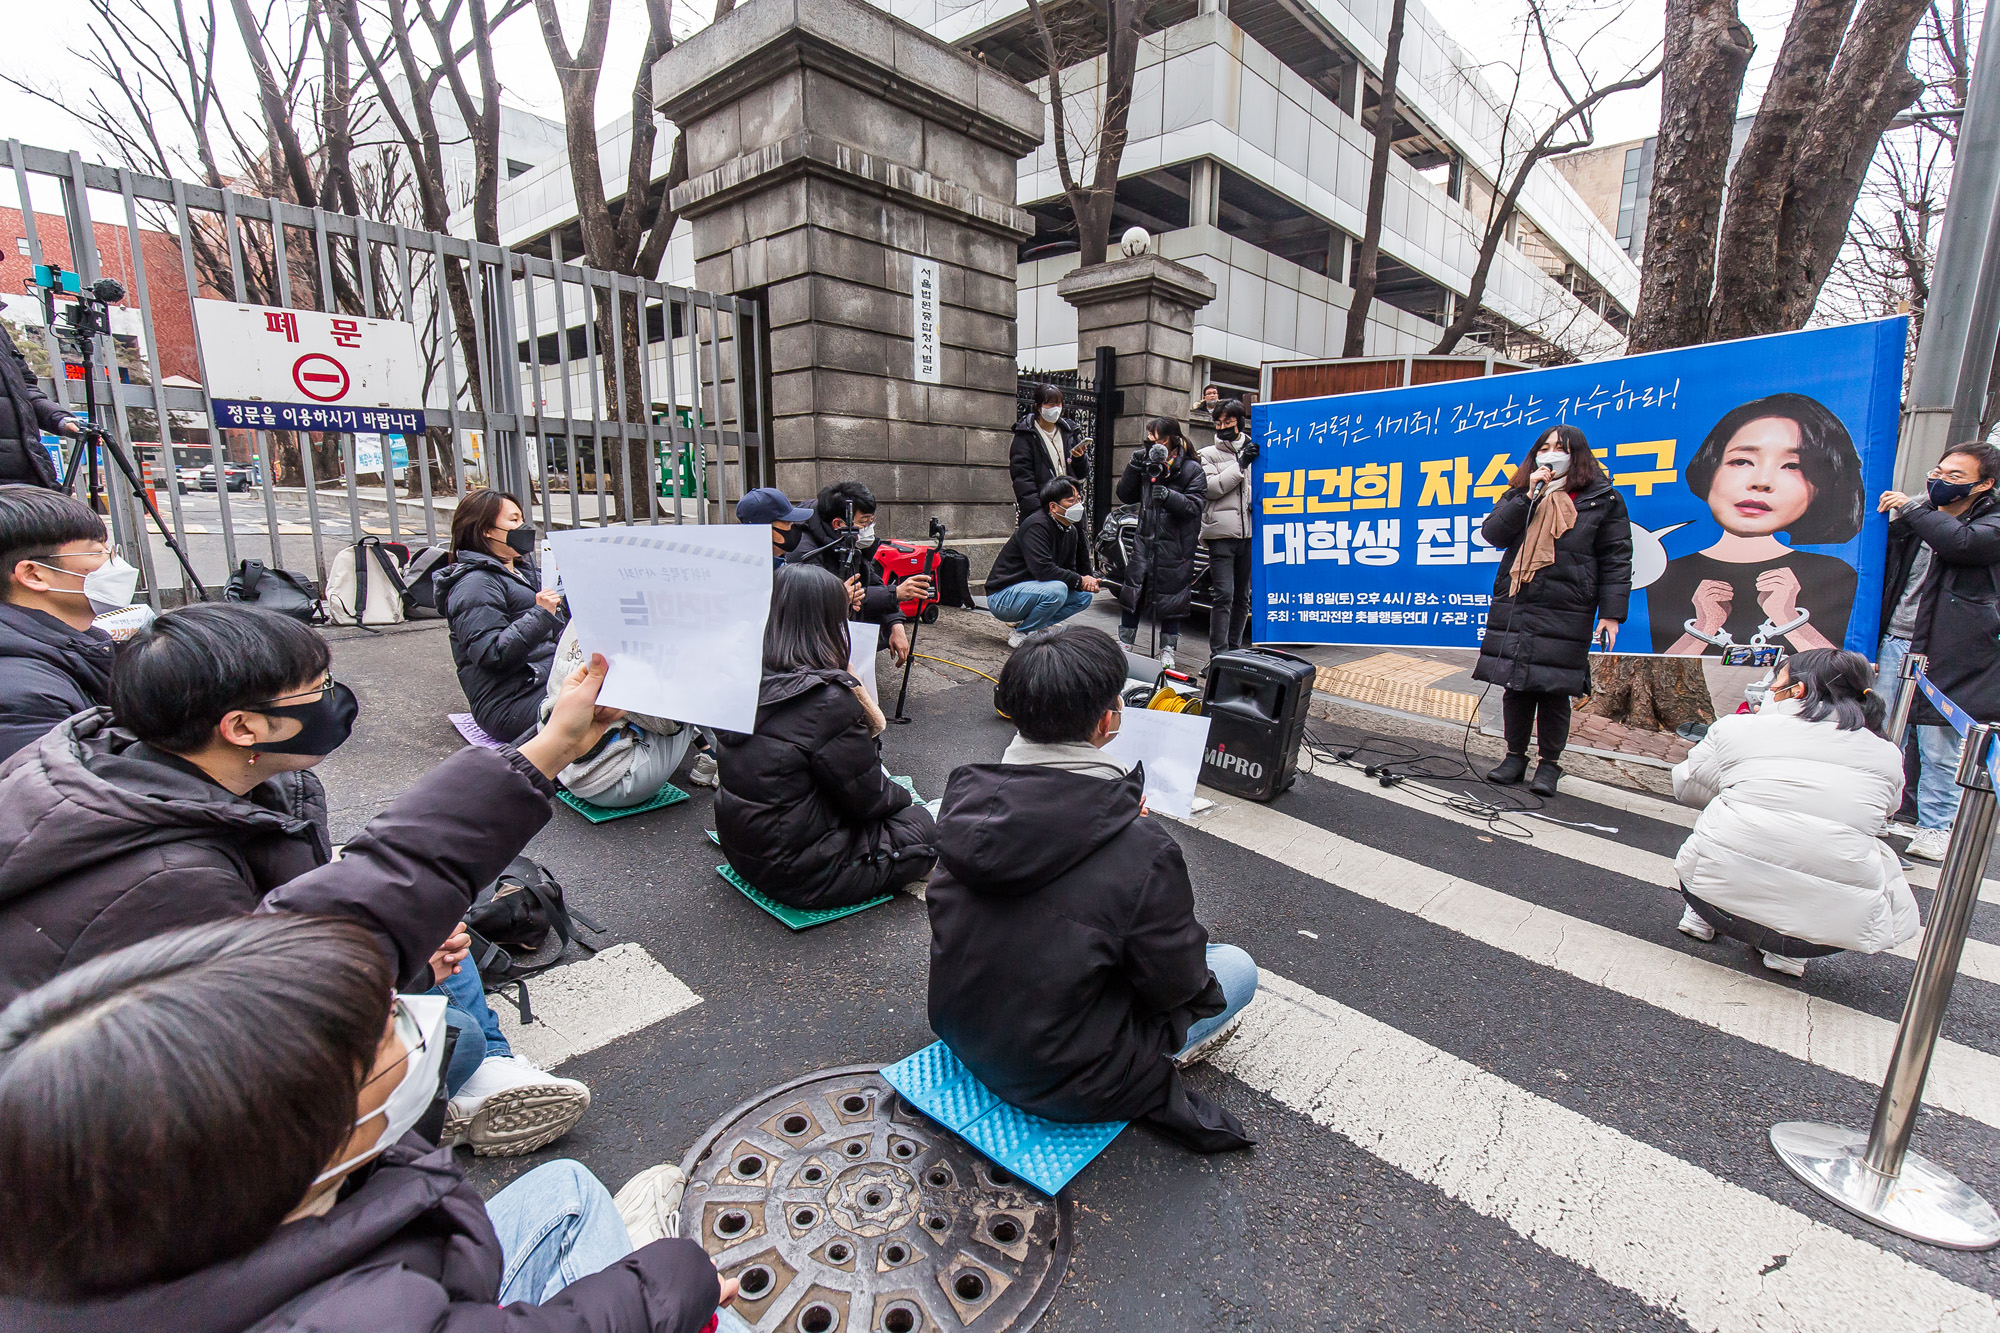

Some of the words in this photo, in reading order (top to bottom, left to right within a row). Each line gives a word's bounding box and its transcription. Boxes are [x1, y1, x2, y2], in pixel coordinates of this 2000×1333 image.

[227, 405, 277, 426] 정문을
[282, 407, 358, 429] 이용하시기
[362, 412, 417, 431] 바랍니다
[1263, 421, 1300, 449] 허위
[1308, 413, 1372, 447] 경력은
[1374, 407, 1441, 438] 사기죄!
[1449, 393, 1550, 434] 김건희는
[1555, 377, 1681, 425] 자수하라!
[1262, 462, 1403, 515] 김건희
[1417, 453, 1518, 507] 자수
[1590, 439, 1678, 496] 구
[1262, 518, 1401, 566] 대학생
[1267, 592, 1290, 605] 일시
[1297, 592, 1314, 605] 1월
[1316, 592, 1355, 606] 8일(토)
[1356, 591, 1381, 605] 오후
[1382, 591, 1404, 605] 4시
[1414, 591, 1440, 606] 장소
[1267, 610, 1289, 623] 주최
[1297, 610, 1354, 624] 개혁과전환
[1355, 610, 1429, 625] 촛불행동연대
[1441, 611, 1469, 626] 주관
